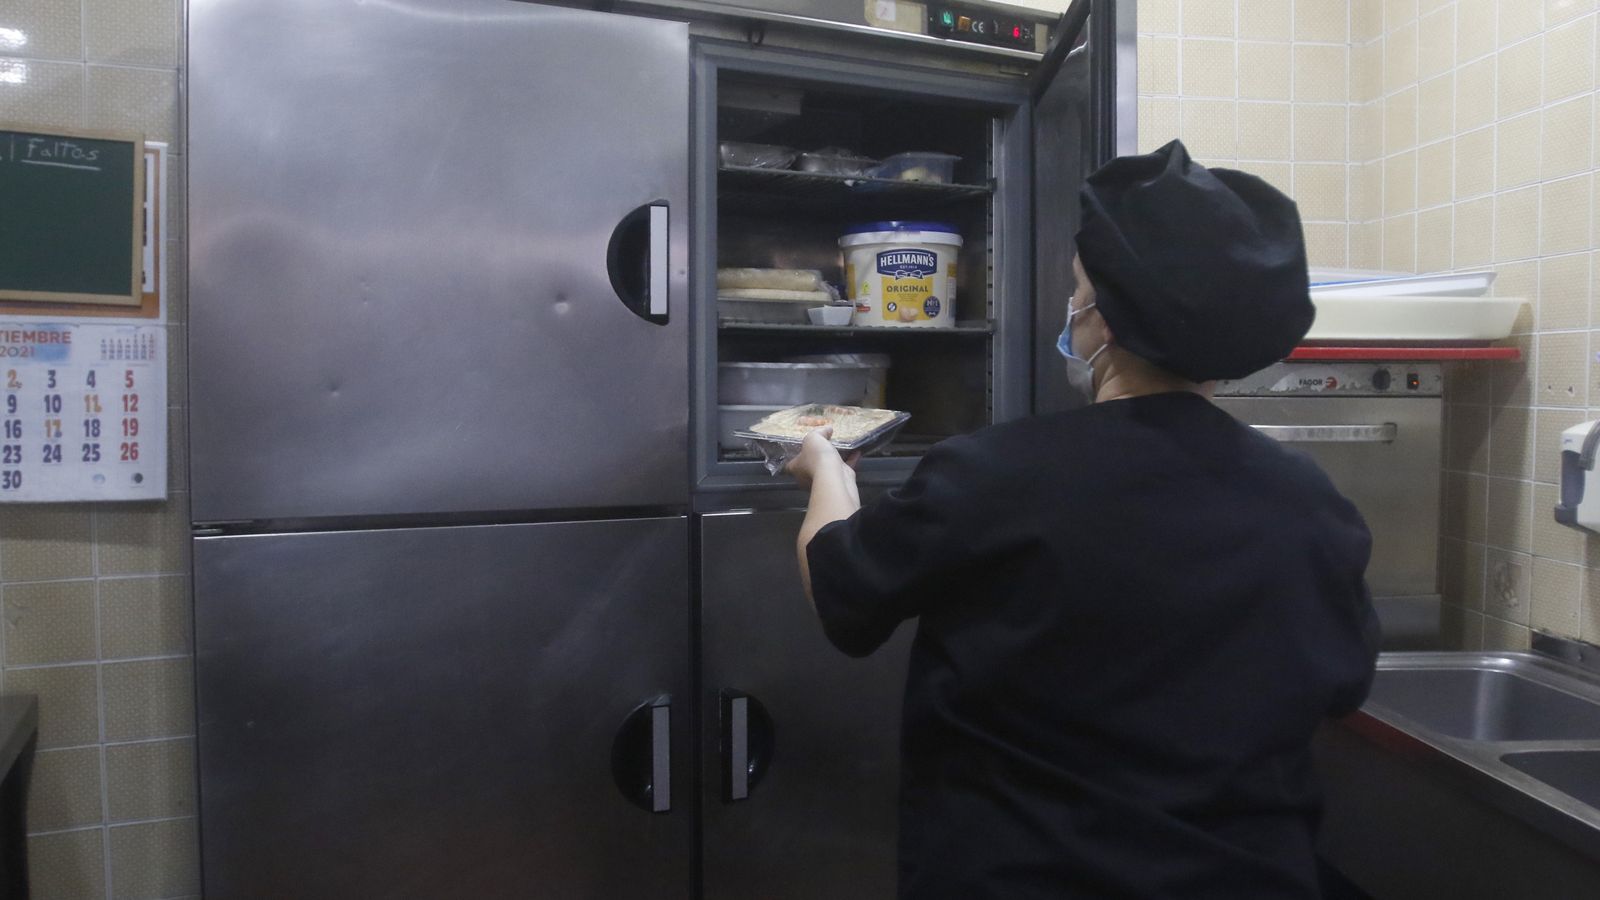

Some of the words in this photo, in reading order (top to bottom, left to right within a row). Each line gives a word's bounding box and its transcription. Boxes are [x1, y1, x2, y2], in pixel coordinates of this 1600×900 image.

[880, 253, 935, 268] HELLMANN'S
[886, 285, 929, 293] ORIGINAL
[0, 345, 36, 358] 2021
[7, 369, 17, 388] 2
[47, 369, 57, 389] 3
[86, 370, 96, 388] 4
[125, 370, 134, 389] 5
[7, 394, 17, 413] 9
[44, 394, 62, 413] 10
[122, 393, 139, 412] 12
[4, 419, 22, 439] 16
[44, 419, 62, 438] 17
[83, 418, 101, 438] 18
[122, 417, 139, 437] 19
[2, 444, 22, 464] 23
[42, 444, 62, 463] 24
[82, 443, 101, 462] 25
[120, 442, 139, 461] 26
[2, 470, 22, 490] 30
